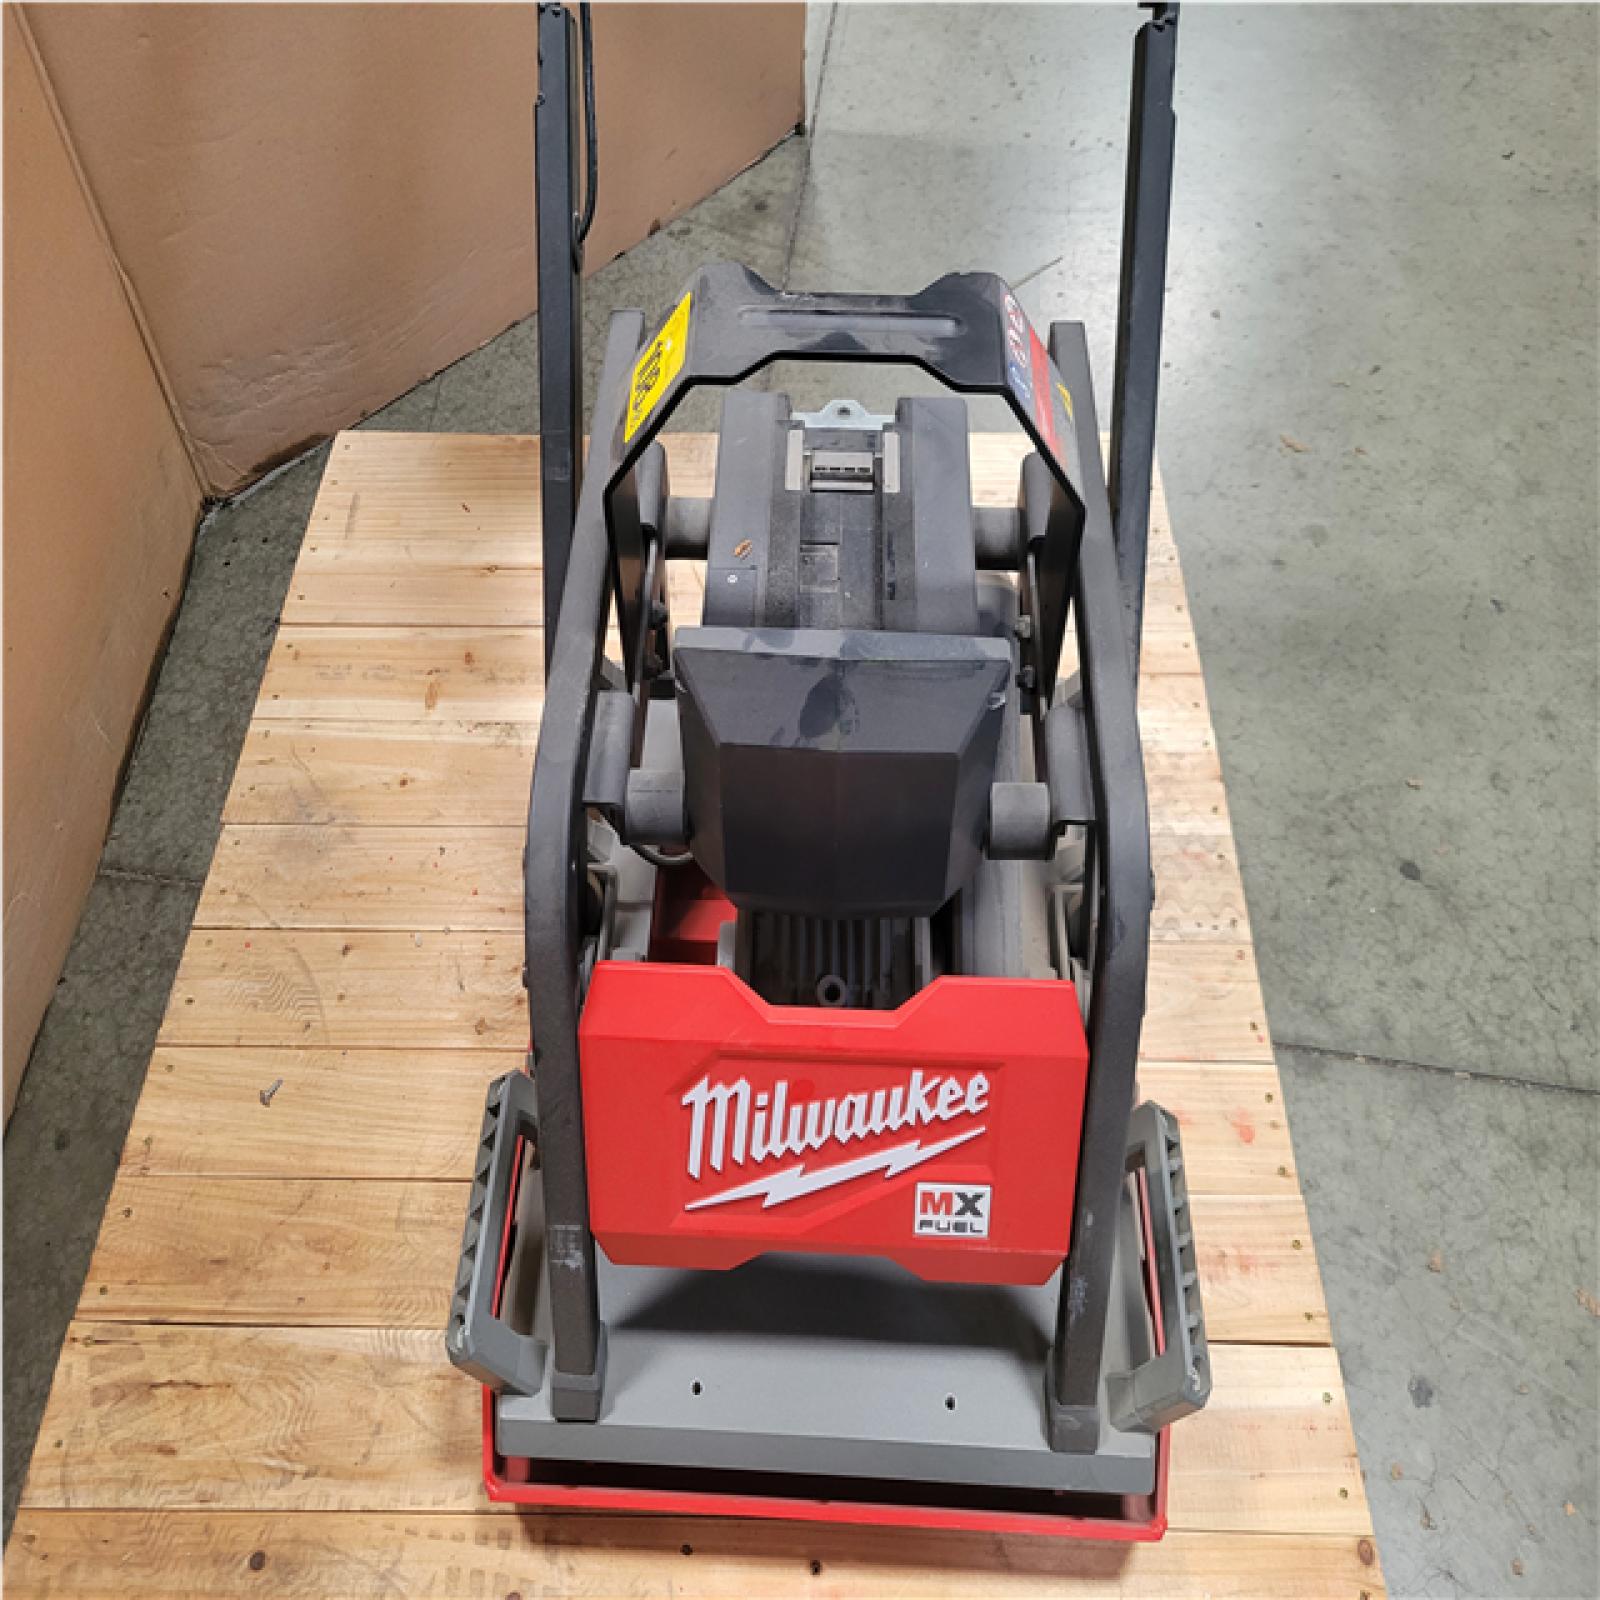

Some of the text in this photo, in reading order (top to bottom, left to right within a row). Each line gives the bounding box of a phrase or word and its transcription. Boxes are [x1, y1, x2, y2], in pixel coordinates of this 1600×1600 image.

[681, 1069, 989, 1180] Milwaukee
[919, 1191, 985, 1217] MX
[918, 1219, 983, 1234] FUEL
